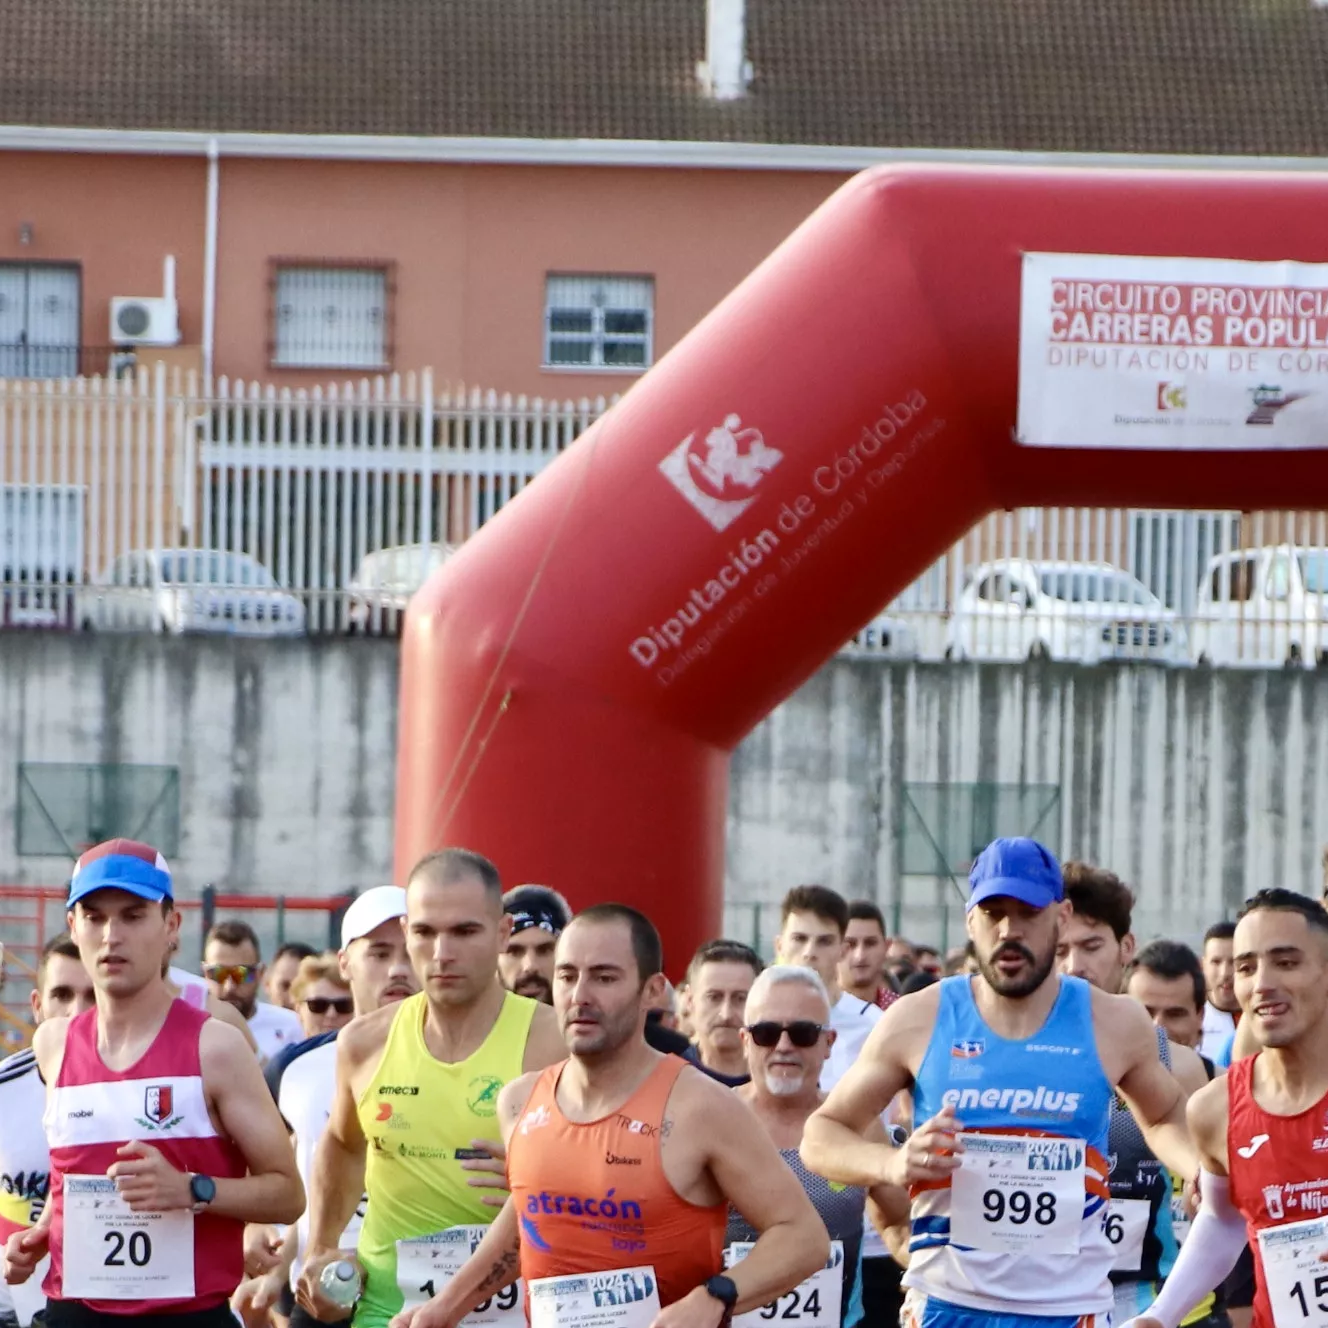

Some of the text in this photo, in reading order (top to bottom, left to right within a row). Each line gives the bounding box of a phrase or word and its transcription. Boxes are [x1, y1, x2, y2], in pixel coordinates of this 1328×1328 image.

[1051, 282, 1181, 314] CIRCUITO
[1050, 311, 1214, 345] CARRERAS
[1048, 345, 1210, 371] DIPUTACIÓN
[1228, 351, 1260, 373] DE
[629, 388, 928, 669] Diputación de Córdoba
[942, 1085, 1082, 1114] enerplus
[616, 1114, 659, 1138] TRACK
[1027, 1143, 1061, 1157] 2024
[527, 1188, 642, 1220] atracón
[983, 1188, 1057, 1226] 998
[104, 1230, 152, 1267] 20
